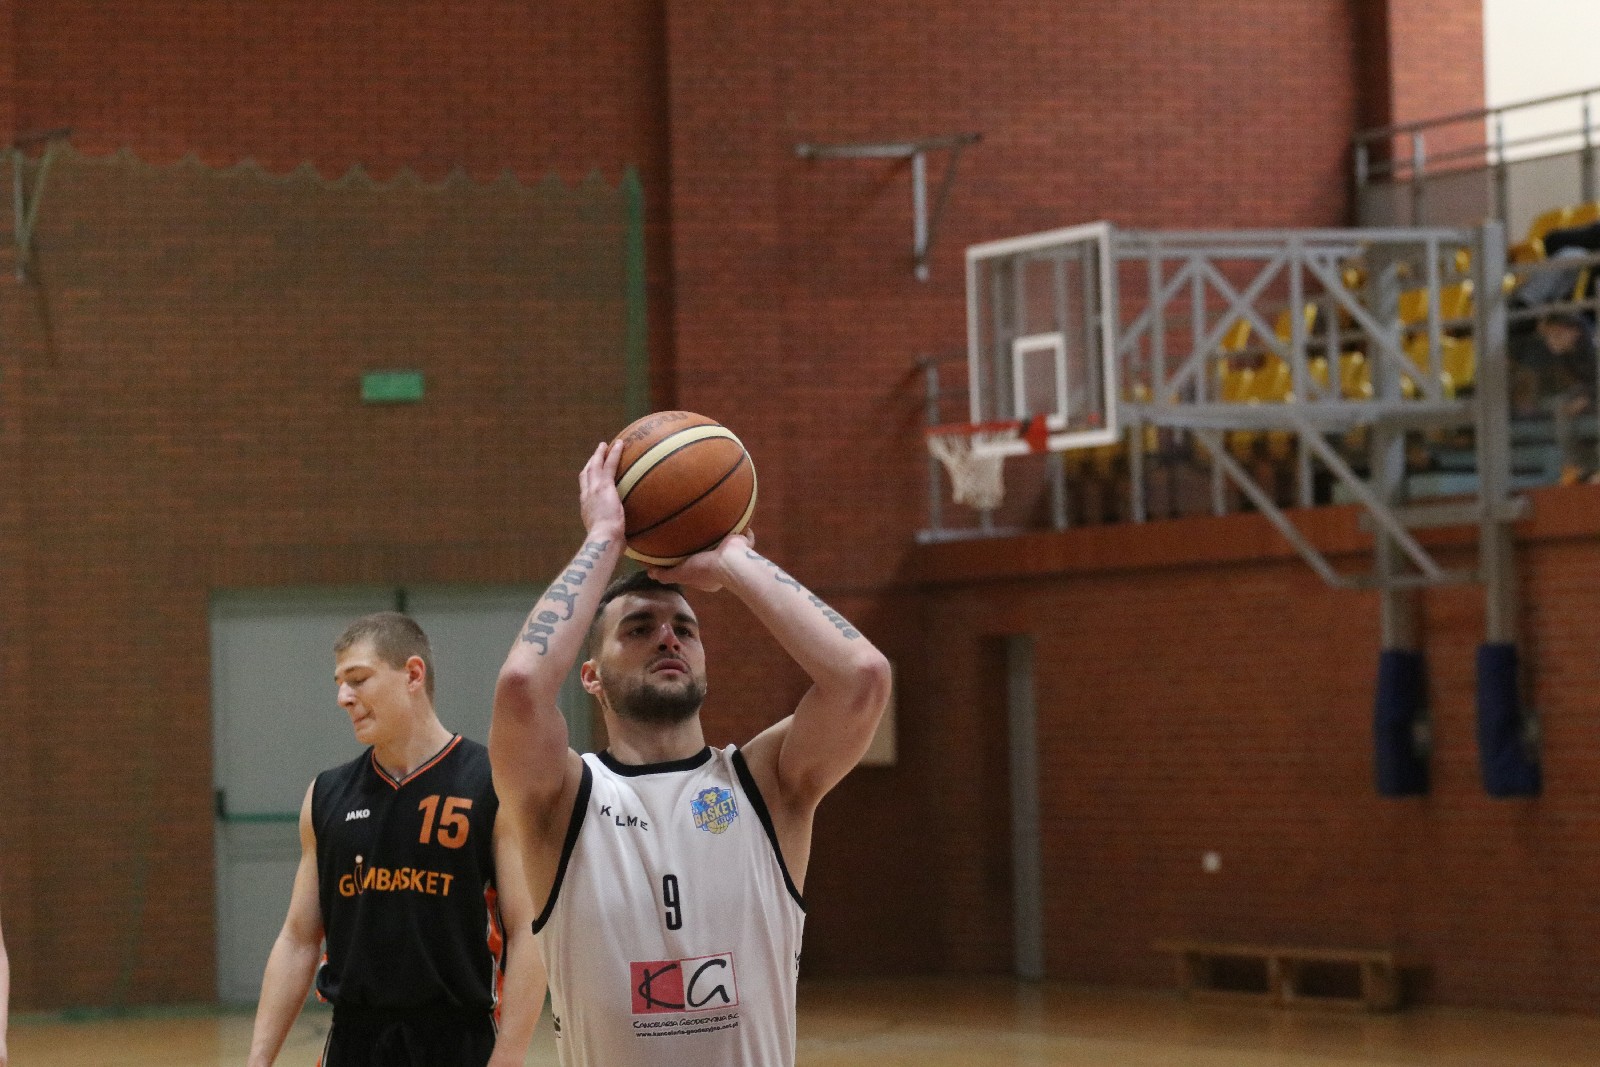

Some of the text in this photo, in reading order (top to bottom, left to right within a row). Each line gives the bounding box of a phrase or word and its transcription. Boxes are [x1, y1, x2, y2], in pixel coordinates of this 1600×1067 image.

[522, 610, 560, 656] No
[344, 808, 371, 822] JAKO
[417, 794, 474, 850] 15
[692, 797, 735, 828] BASKET
[662, 873, 683, 931] 9
[637, 958, 731, 1010] KG
